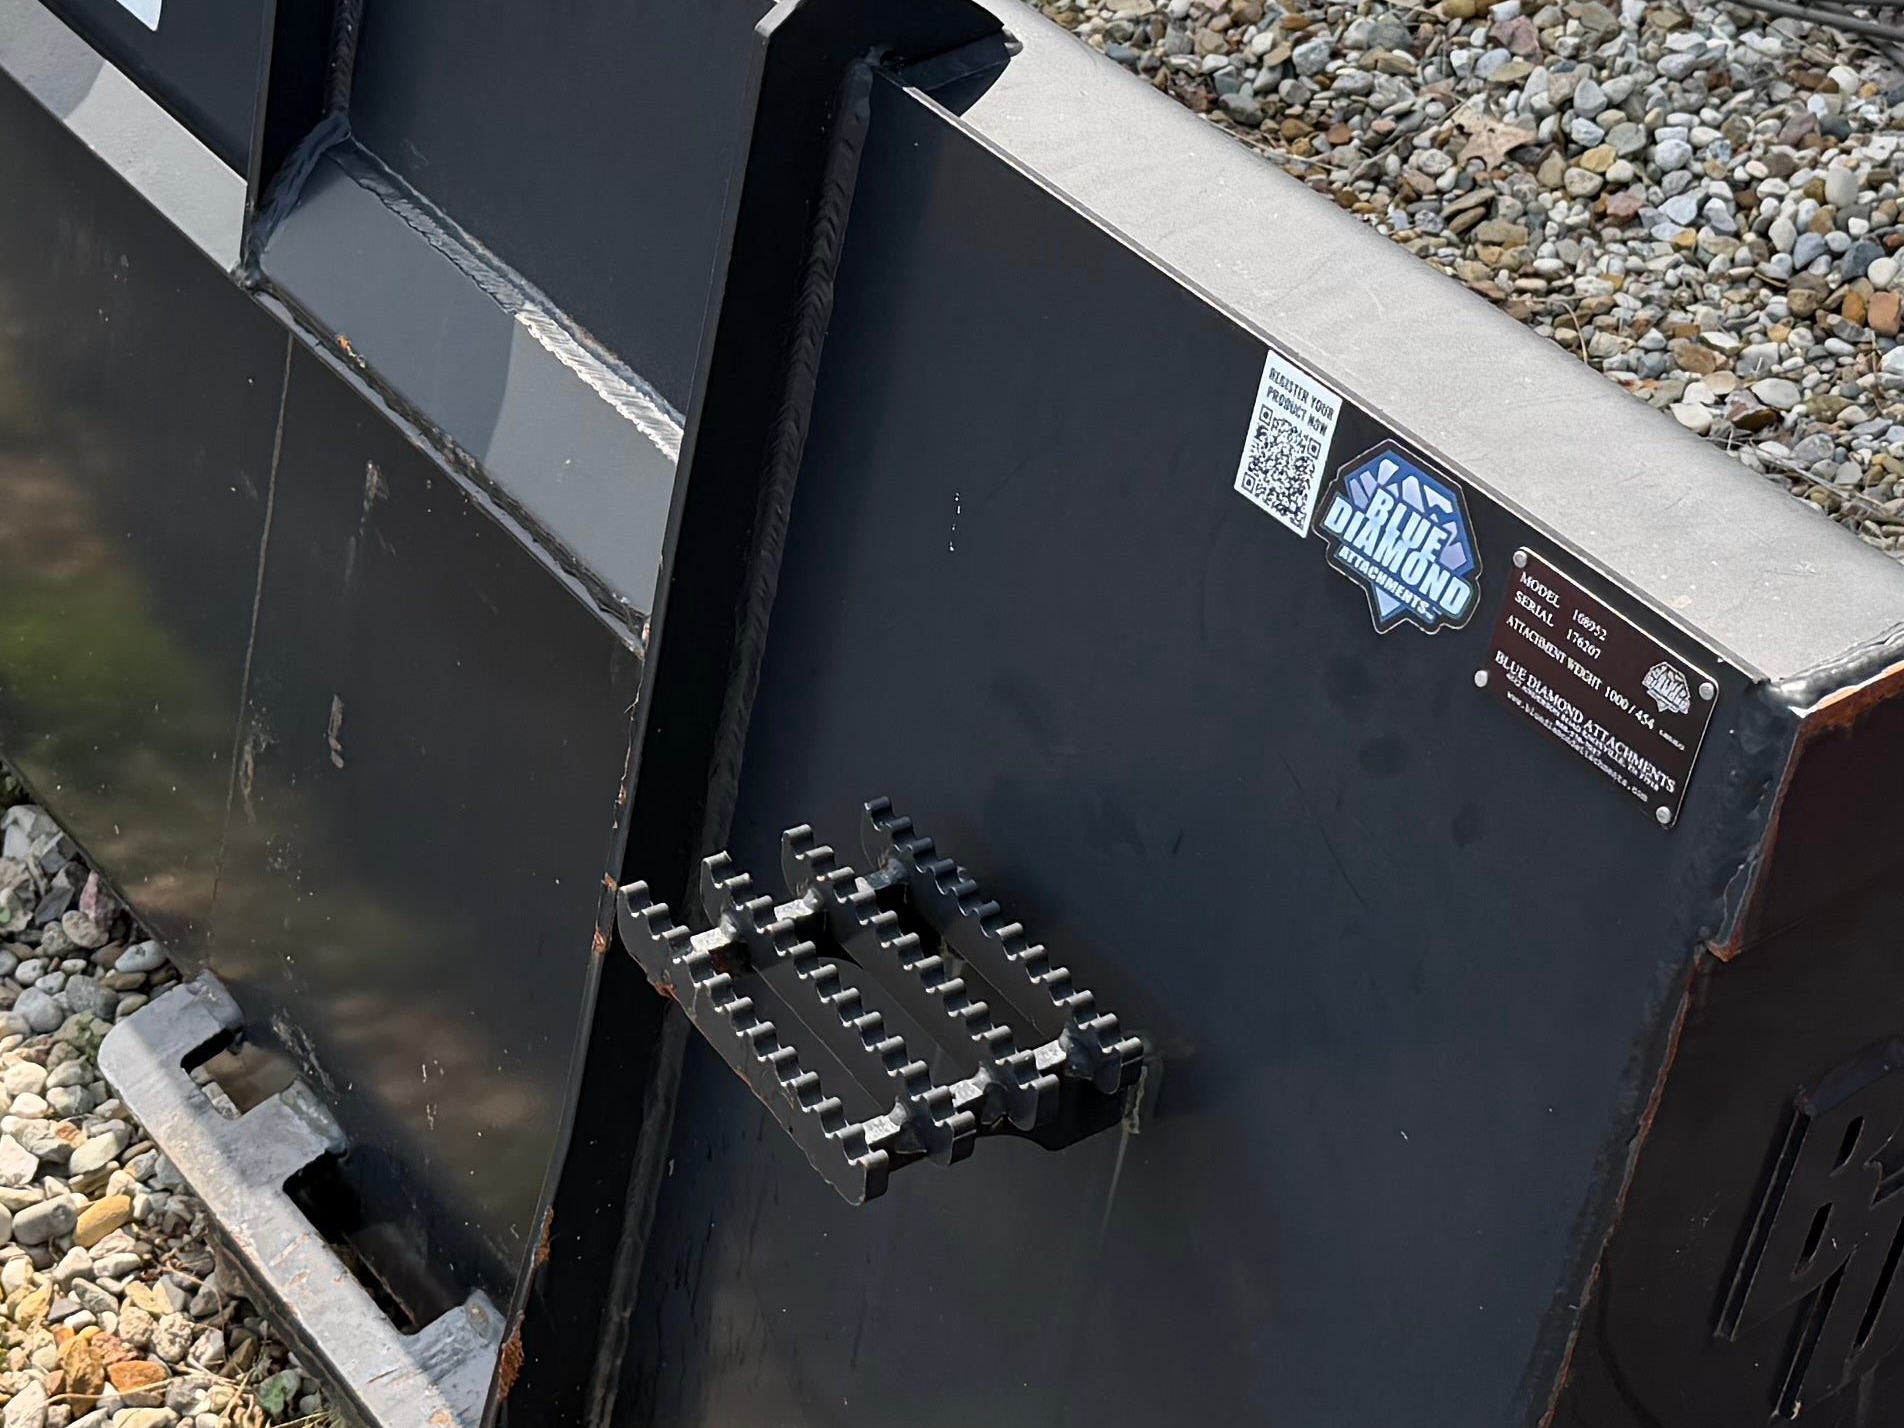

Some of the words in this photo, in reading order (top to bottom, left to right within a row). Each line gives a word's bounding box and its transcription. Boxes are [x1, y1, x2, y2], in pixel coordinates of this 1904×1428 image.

[1266, 386, 1308, 422] PRODUCT
[1307, 413, 1328, 437] NOW
[1268, 367, 1310, 404] REGISTER
[1310, 395, 1335, 421] YOUR
[1323, 496, 1472, 615] DIAMOND
[1365, 487, 1449, 563] BLUE
[1338, 545, 1431, 616] ATTACHMENTS
[1520, 571, 1561, 608] MODEL
[1515, 590, 1555, 628] SERIAL
[1566, 628, 1602, 659] 176207
[1506, 614, 1567, 664] ATTACHMENT
[1604, 686, 1629, 711] 1000
[1635, 709, 1655, 730] 454
[1495, 650, 1527, 681] BLUE
[1527, 674, 1584, 723] DIAMOND
[1583, 719, 1676, 793] ATTACHMENTS
